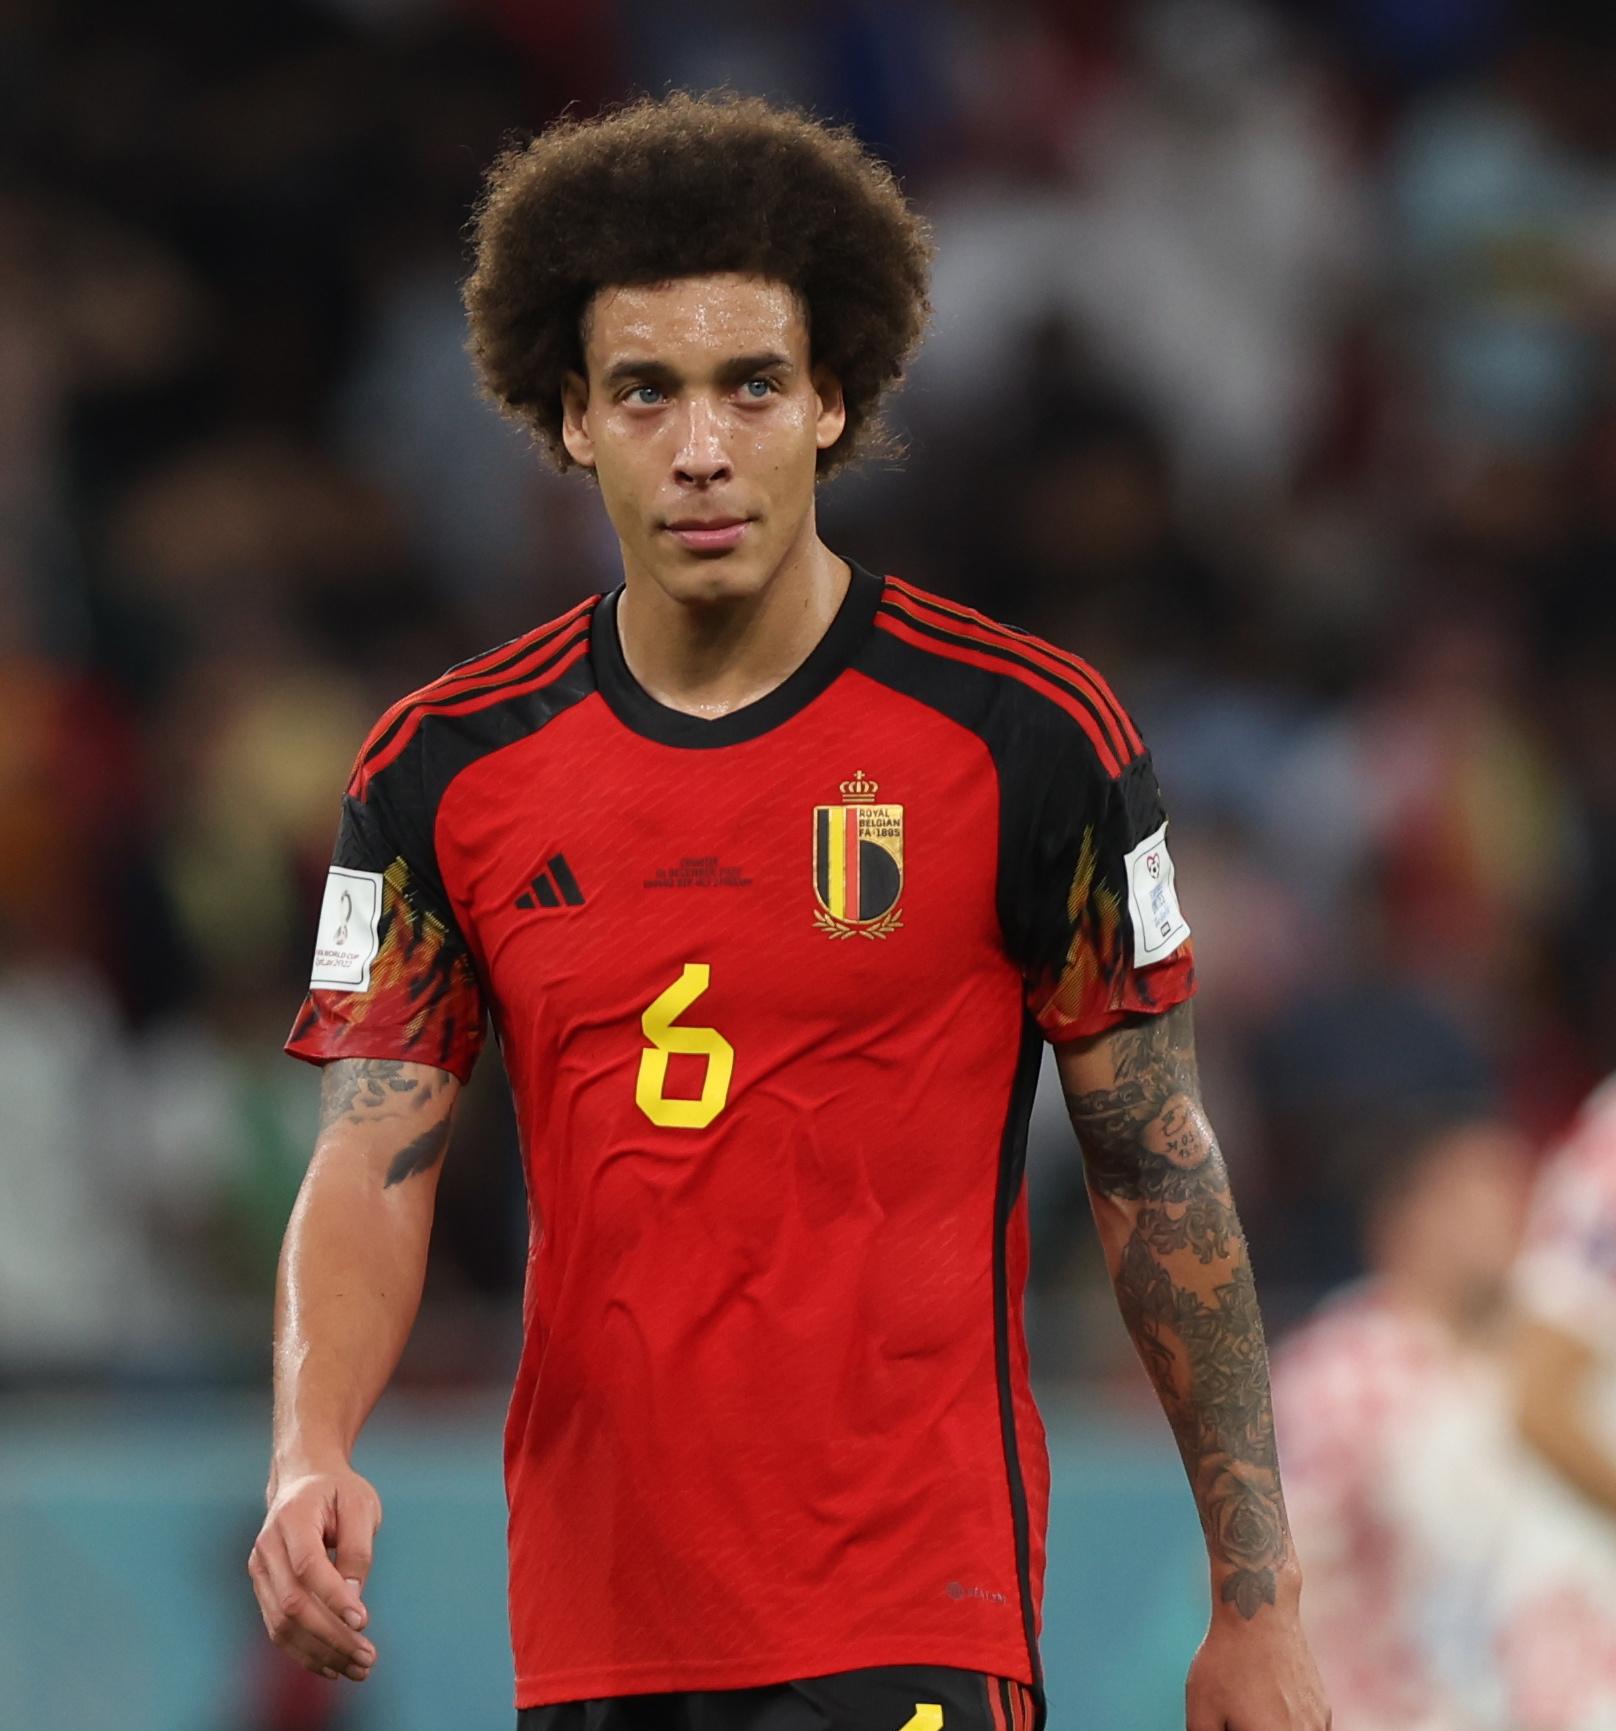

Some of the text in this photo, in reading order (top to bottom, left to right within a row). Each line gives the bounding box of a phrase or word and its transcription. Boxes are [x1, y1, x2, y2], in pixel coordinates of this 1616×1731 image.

[859, 808, 889, 818] ROYAL
[859, 819, 900, 828] BELGIAN
[635, 963, 734, 1129] 6
